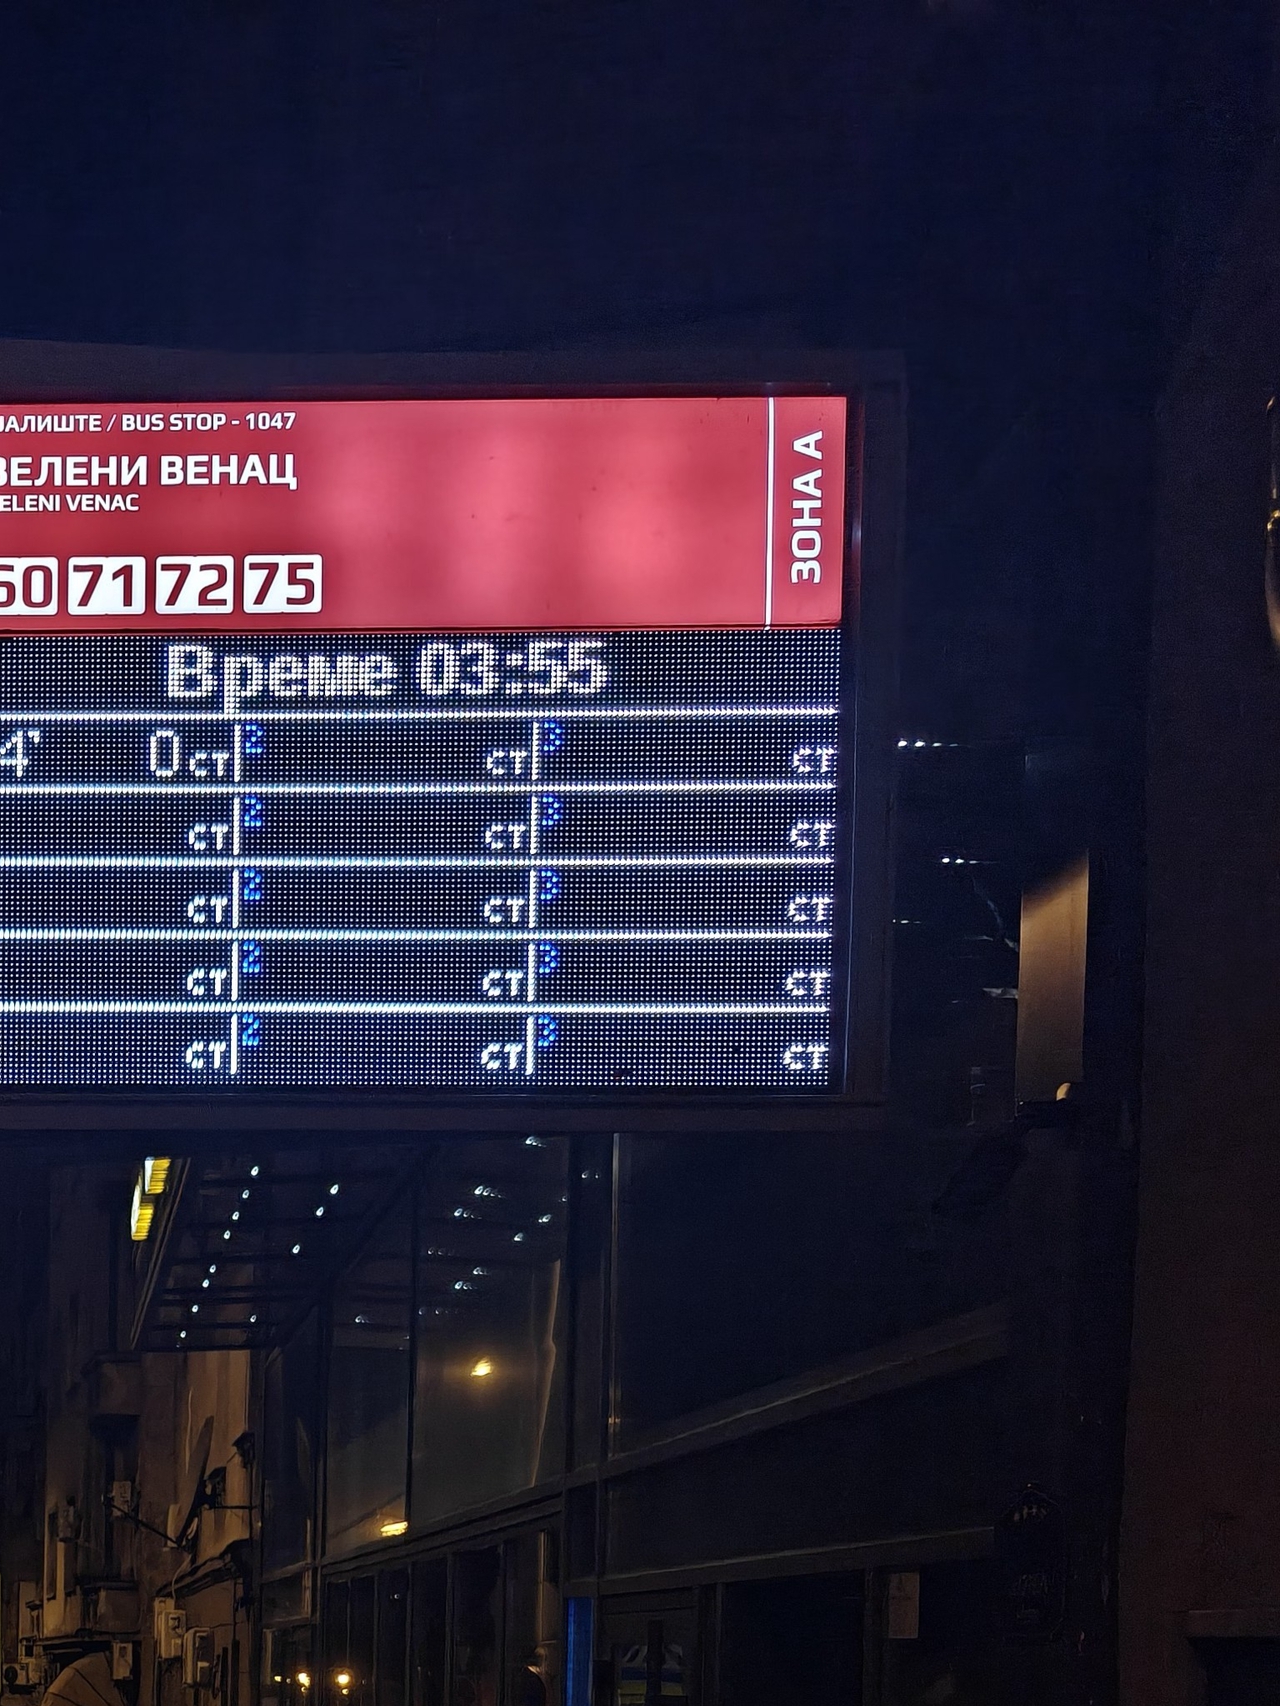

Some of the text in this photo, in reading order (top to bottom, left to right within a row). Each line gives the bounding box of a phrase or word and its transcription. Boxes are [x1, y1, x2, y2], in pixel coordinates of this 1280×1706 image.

[122, 414, 166, 432] BUS
[169, 413, 227, 432] STOP
[245, 412, 297, 431] 1047
[160, 453, 298, 491] ВЕНАЦ
[66, 494, 140, 512] VENAC
[792, 469, 823, 584] ЗОНА
[72, 564, 142, 607] 71
[162, 564, 228, 607] 72
[248, 562, 316, 606] 75
[167, 641, 610, 715] Време 03:55
[245, 725, 264, 754] 2
[542, 721, 562, 751] 3
